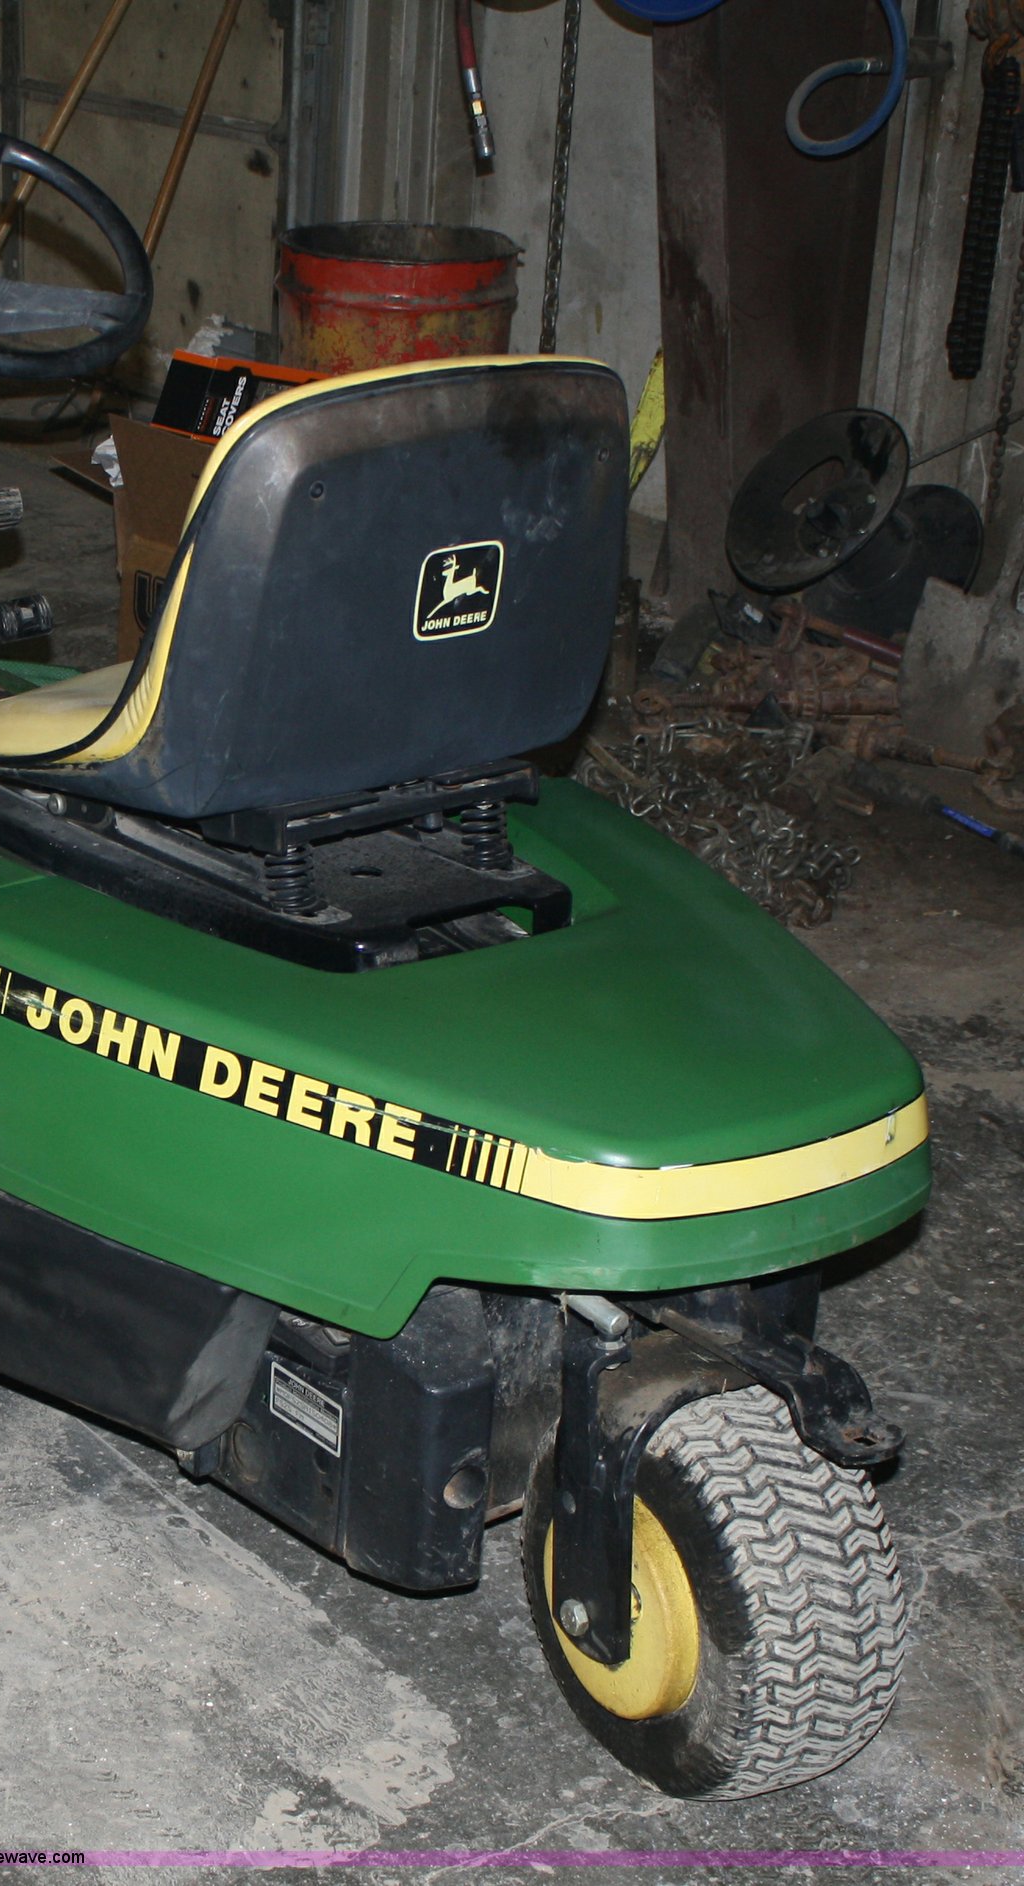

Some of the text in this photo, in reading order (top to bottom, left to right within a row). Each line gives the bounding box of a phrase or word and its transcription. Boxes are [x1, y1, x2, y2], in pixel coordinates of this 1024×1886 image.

[213, 398, 230, 436] SEAT
[421, 610, 488, 632] JOHN DEERE
[26, 987, 422, 1160] JOHN DEERE
